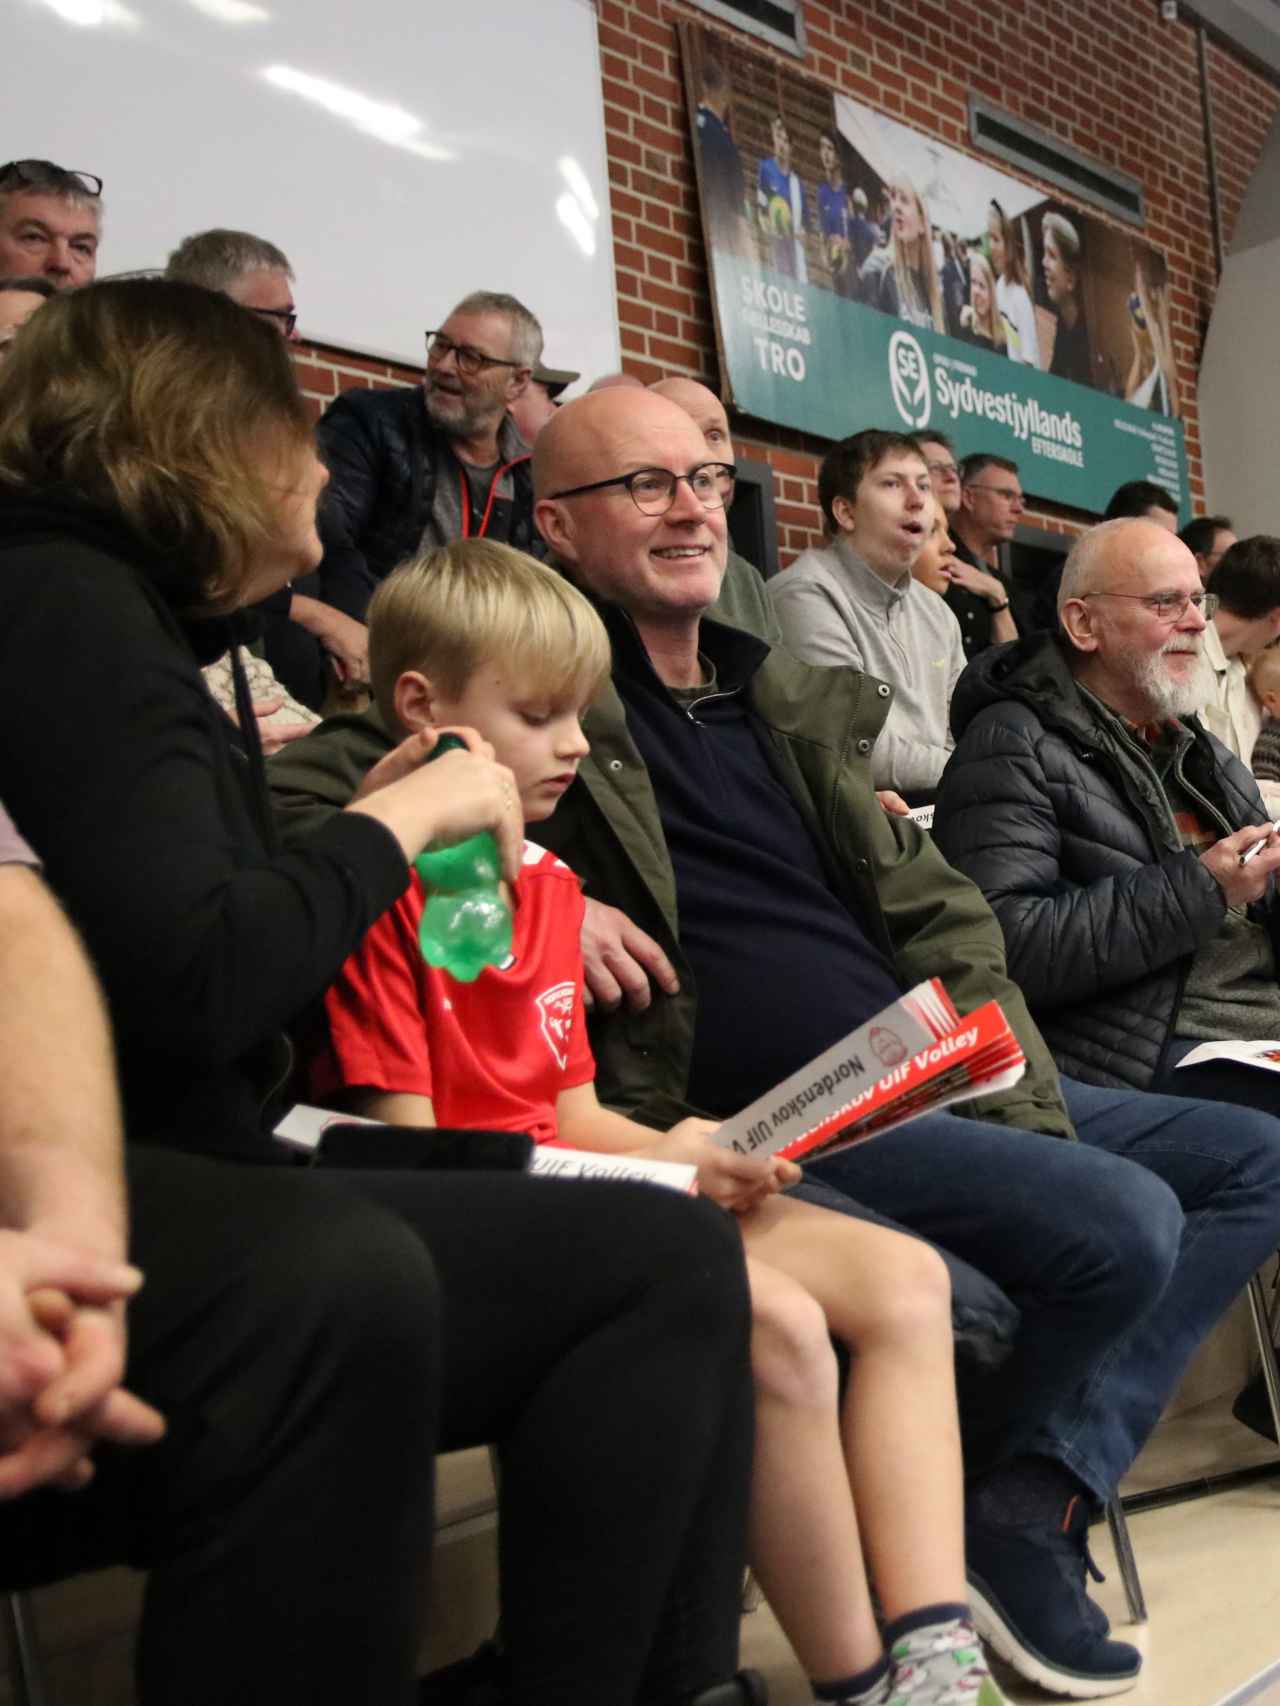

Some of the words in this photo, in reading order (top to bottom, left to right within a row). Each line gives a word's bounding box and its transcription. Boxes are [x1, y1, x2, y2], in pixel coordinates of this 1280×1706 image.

[741, 275, 807, 322] SKOLE
[753, 336, 806, 382] TRO
[898, 347, 919, 379] SE
[934, 366, 1082, 448] Sydvestjyllands
[879, 1060, 912, 1091] UIF
[914, 1026, 979, 1071] Volley
[771, 1054, 866, 1127] Nordenskov
[747, 1120, 774, 1151] UIF
